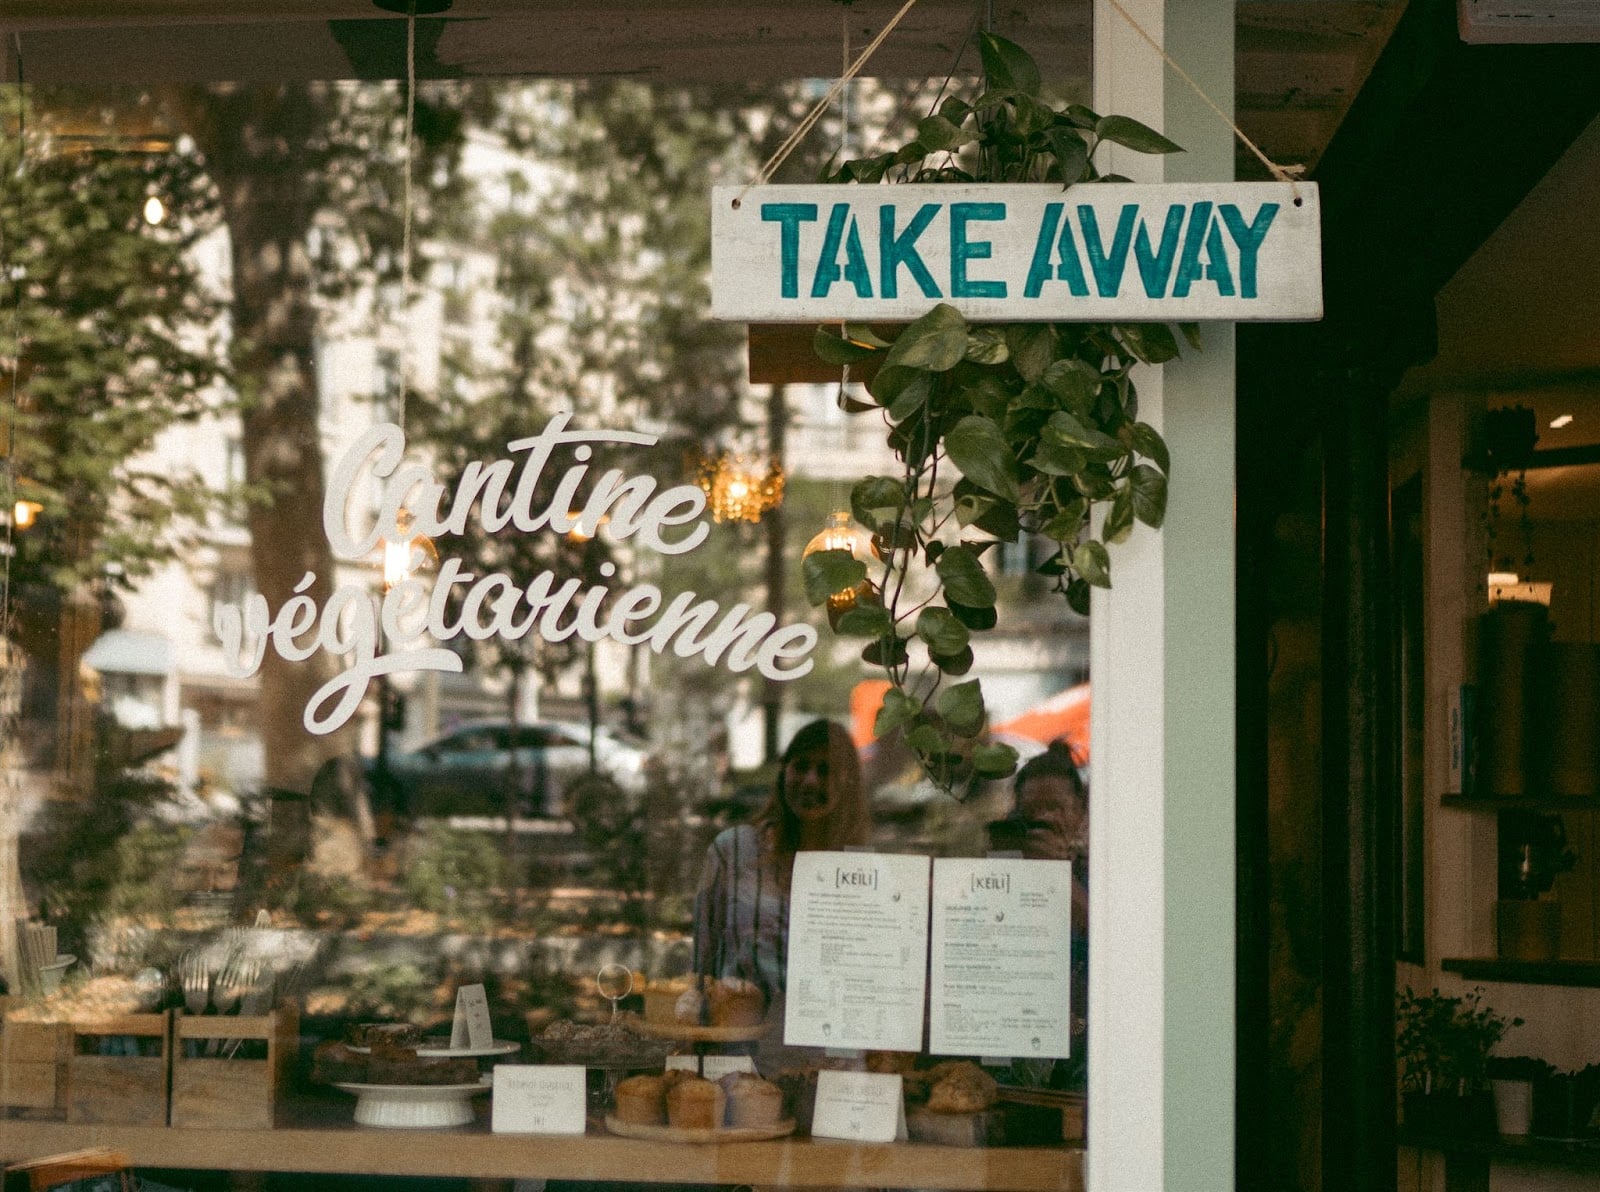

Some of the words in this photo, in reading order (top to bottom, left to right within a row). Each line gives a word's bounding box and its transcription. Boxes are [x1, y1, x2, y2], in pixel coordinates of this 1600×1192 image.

[761, 202, 1007, 298] TAKE
[1023, 201, 1280, 299] AWAY
[323, 411, 711, 559] Cantine
[213, 551, 819, 735] végétarienne
